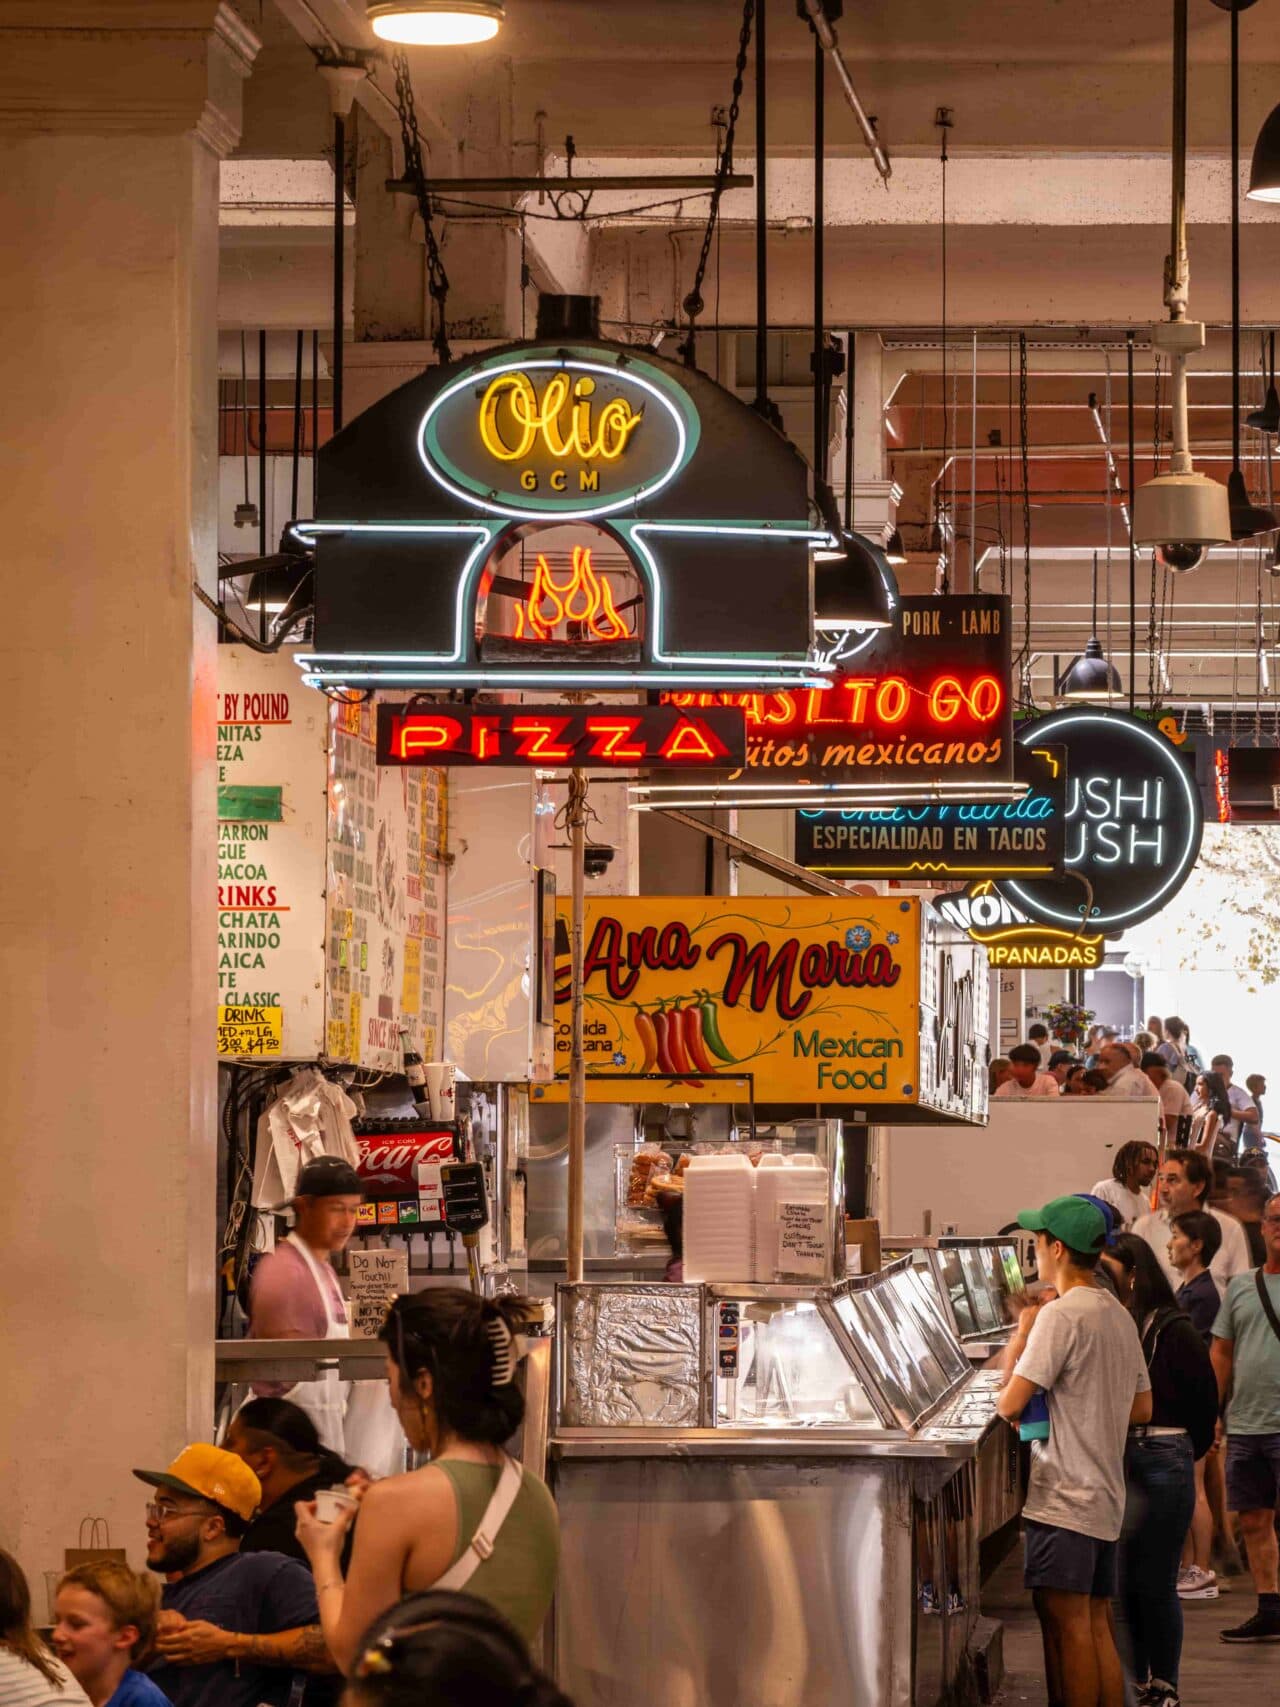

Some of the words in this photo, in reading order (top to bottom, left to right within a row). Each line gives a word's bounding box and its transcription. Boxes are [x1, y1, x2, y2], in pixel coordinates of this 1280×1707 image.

[479, 371, 645, 460] Olio
[903, 610, 940, 635] PORK
[962, 610, 1000, 635] LAMB
[224, 693, 239, 720] BY
[244, 693, 289, 720] POUND
[844, 676, 909, 724] TO
[928, 675, 1002, 724] GO
[217, 725, 262, 742] NITAS
[391, 715, 731, 759] PIZZA
[217, 745, 244, 761] EZA
[821, 735, 1003, 768] mexicanos
[217, 824, 268, 841] ARRON
[813, 826, 943, 850] ESPECIALIDAD
[954, 827, 977, 850] EN
[988, 827, 1047, 851] TACOS
[218, 843, 246, 859] GUE
[217, 886, 277, 906] RINKS
[219, 912, 281, 928] CHATA
[218, 932, 280, 949] ARINDO
[219, 952, 265, 968] AICA
[988, 947, 1097, 964] PANADAS
[554, 916, 701, 1005] Ana
[706, 932, 900, 1021] Maria
[218, 972, 237, 988] TE
[224, 992, 280, 1008] CLASSIC
[224, 1008, 266, 1023] DRINK
[554, 1019, 607, 1036] Coida
[793, 1030, 904, 1058] Mexican
[818, 1062, 888, 1090] Food
[352, 1255, 369, 1269] Do
